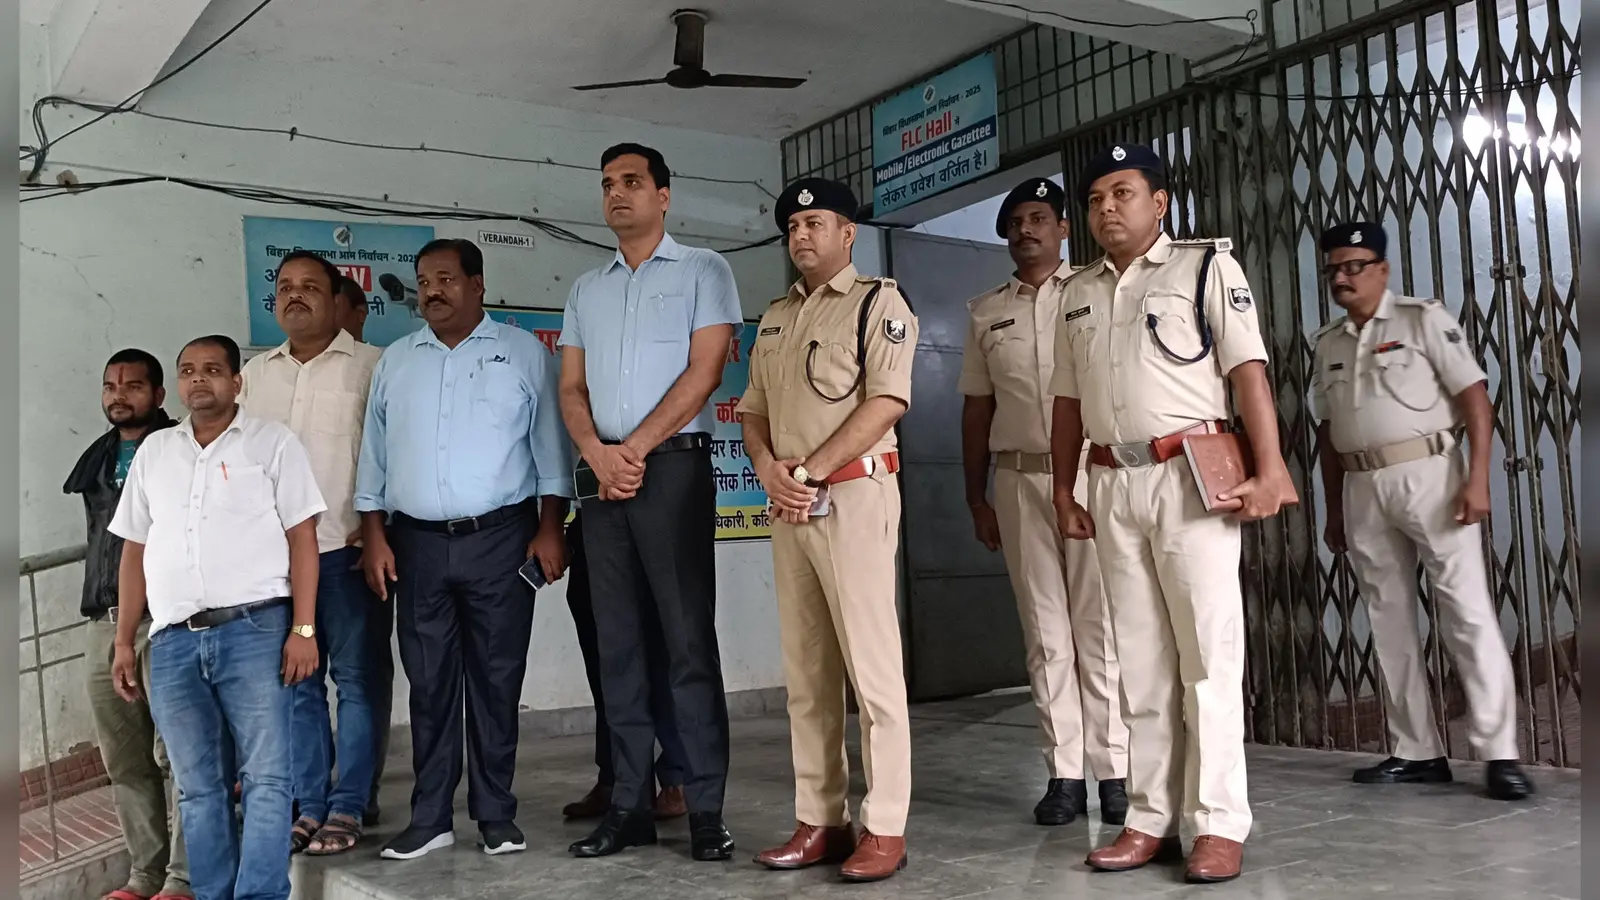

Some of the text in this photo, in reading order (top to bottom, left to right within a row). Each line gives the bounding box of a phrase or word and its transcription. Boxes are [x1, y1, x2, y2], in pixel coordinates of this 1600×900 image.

[965, 84, 982, 98] 2025
[901, 125, 922, 151] FLC
[925, 111, 952, 140] Hall
[876, 124, 991, 184] Mobile/Electronic Gazettee
[881, 185, 907, 206] लेकर
[910, 172, 936, 195] प्रवेश
[939, 156, 970, 182] वर्जित
[265, 245, 290, 258] बिहार
[339, 250, 356, 261] आम
[358, 250, 389, 263] निर्वाचन
[483, 233, 530, 247] VERANDAH-1
